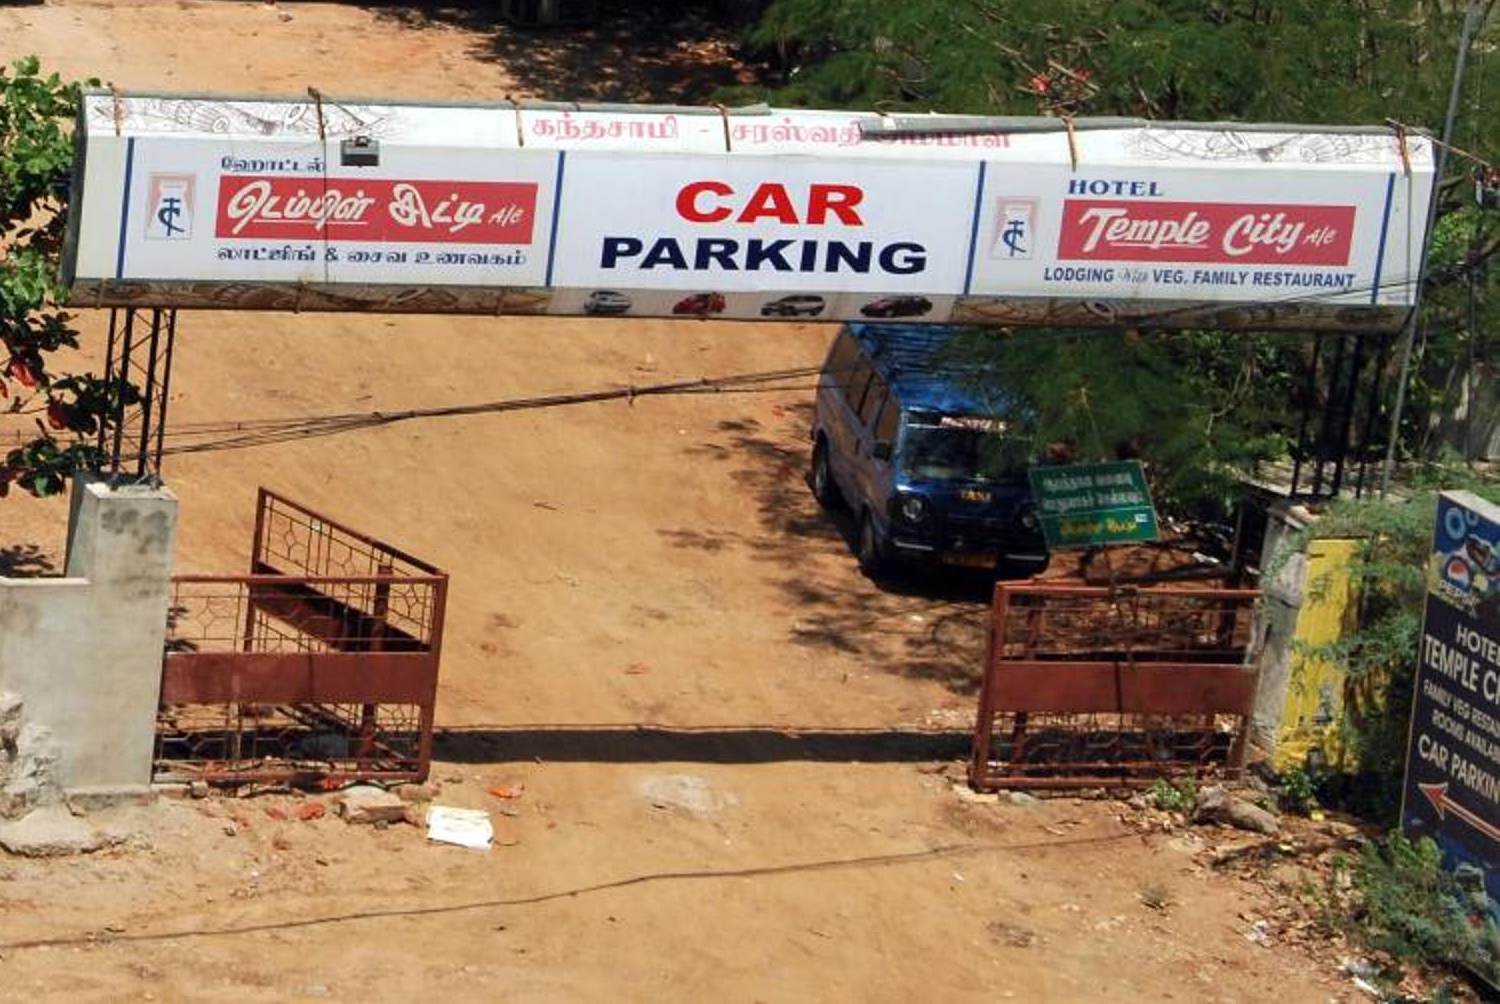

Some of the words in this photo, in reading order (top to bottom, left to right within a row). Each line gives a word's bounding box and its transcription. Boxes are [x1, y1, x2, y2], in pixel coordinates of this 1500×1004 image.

[675, 180, 864, 227] CAR
[1068, 179, 1164, 196] HOTEL
[1079, 207, 1211, 253] Temple
[1222, 212, 1305, 256] City
[324, 247, 339, 263] &
[600, 237, 928, 275] PARKING
[1043, 267, 1114, 283] LODGING
[1193, 270, 1248, 286] FAMILY
[1252, 271, 1357, 288] RESTAURANT
[1424, 633, 1480, 693] TEMPLE
[1418, 734, 1449, 771] CAR
